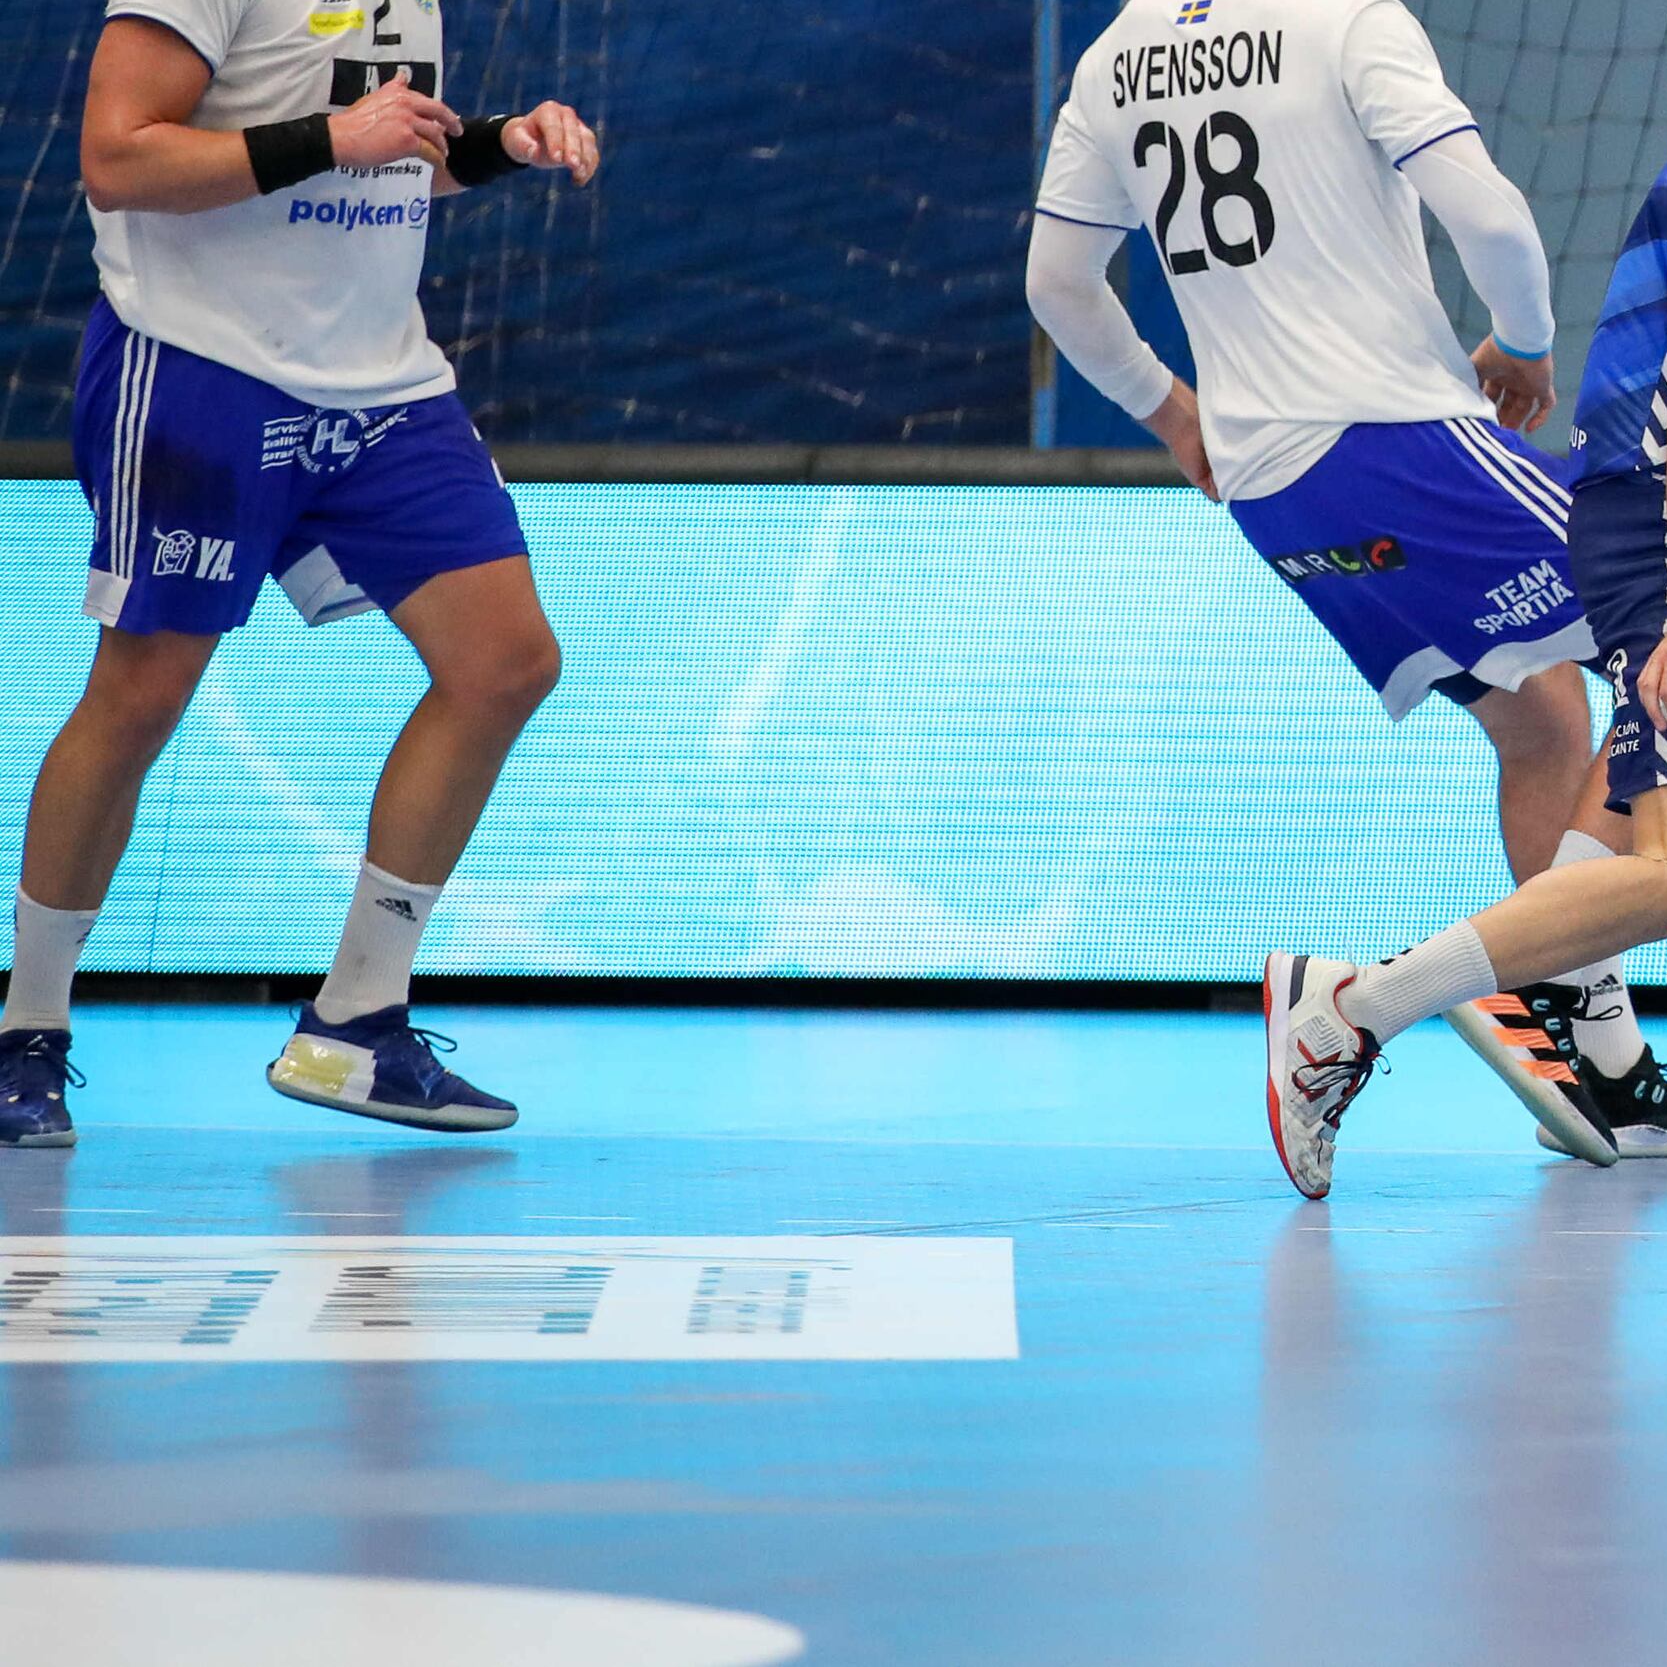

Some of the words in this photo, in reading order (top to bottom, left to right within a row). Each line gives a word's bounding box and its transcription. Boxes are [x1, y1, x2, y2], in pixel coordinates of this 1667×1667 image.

[1113, 30, 1283, 108] SVENSSON
[1133, 110, 1275, 275] 28
[1473, 578, 1575, 635] SPORTIA
[1485, 558, 1558, 611] TEAM
